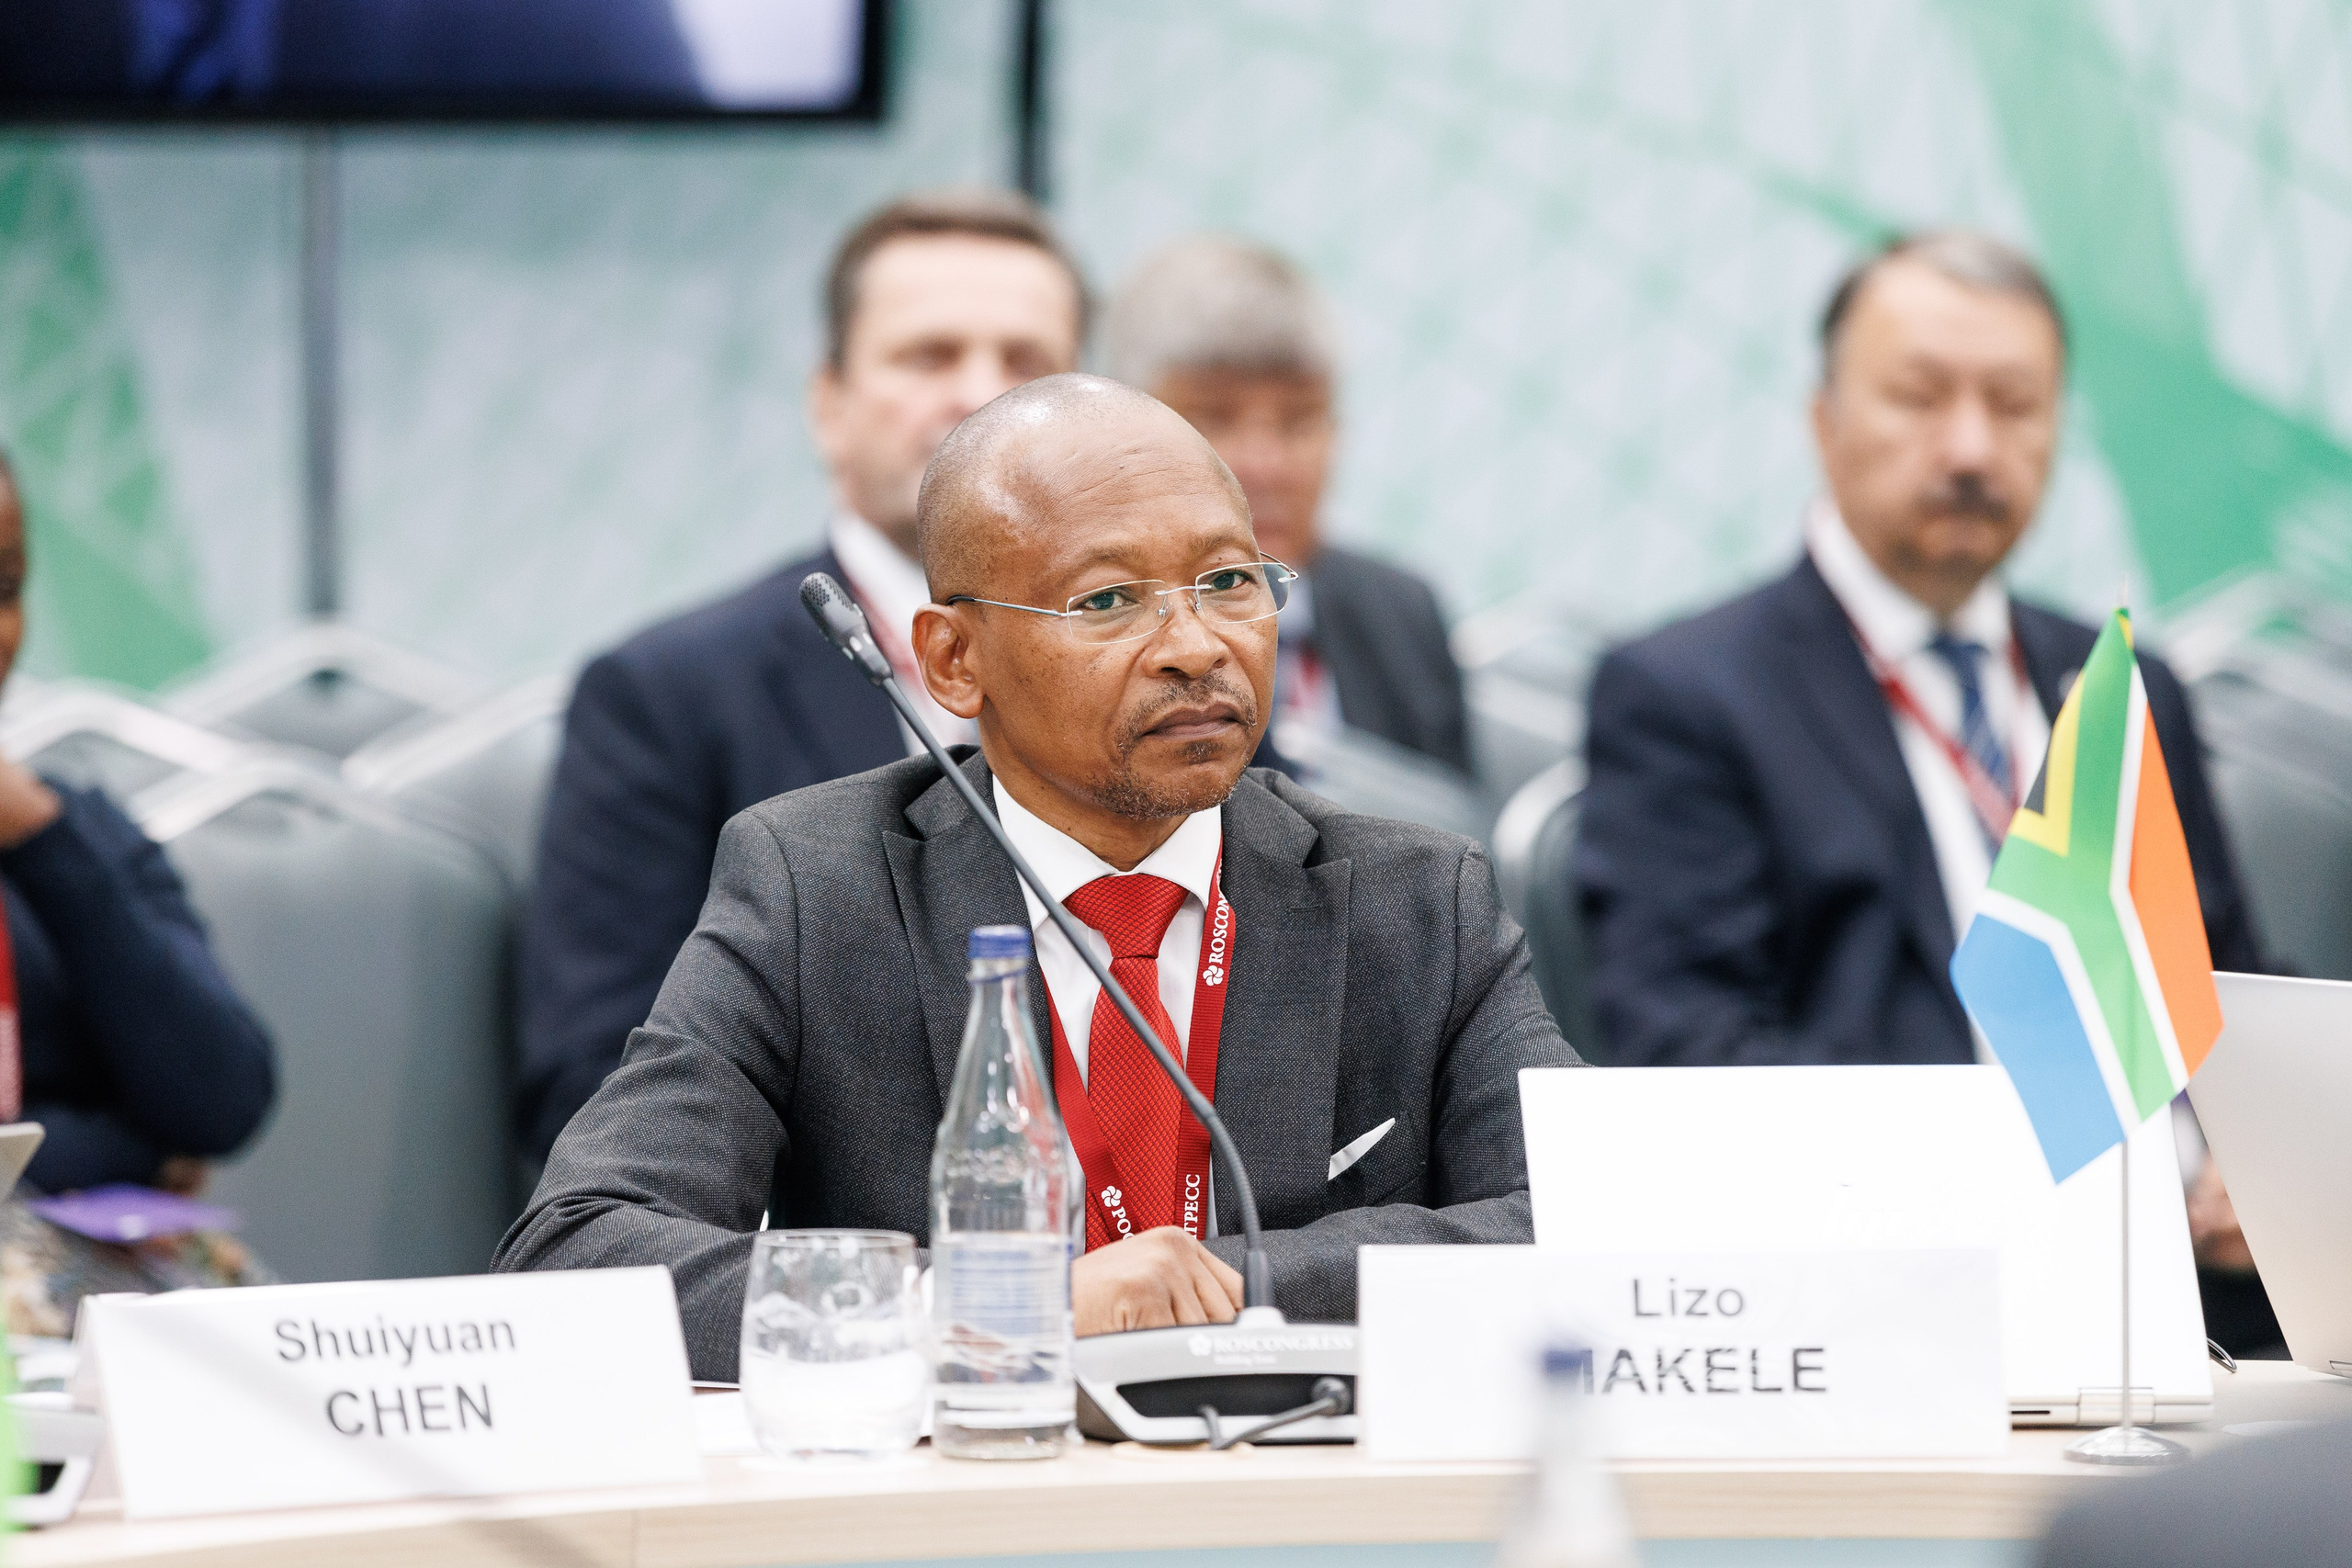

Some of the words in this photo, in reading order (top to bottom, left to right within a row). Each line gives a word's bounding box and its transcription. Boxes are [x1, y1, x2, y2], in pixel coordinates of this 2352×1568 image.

[1208, 878, 1229, 964] ROSCON
[1183, 1174, 1201, 1240] ГРЕСС
[1632, 1278, 1746, 1318] Lizo
[275, 1314, 517, 1369] Shuiyuan
[325, 1383, 496, 1438] CHEN
